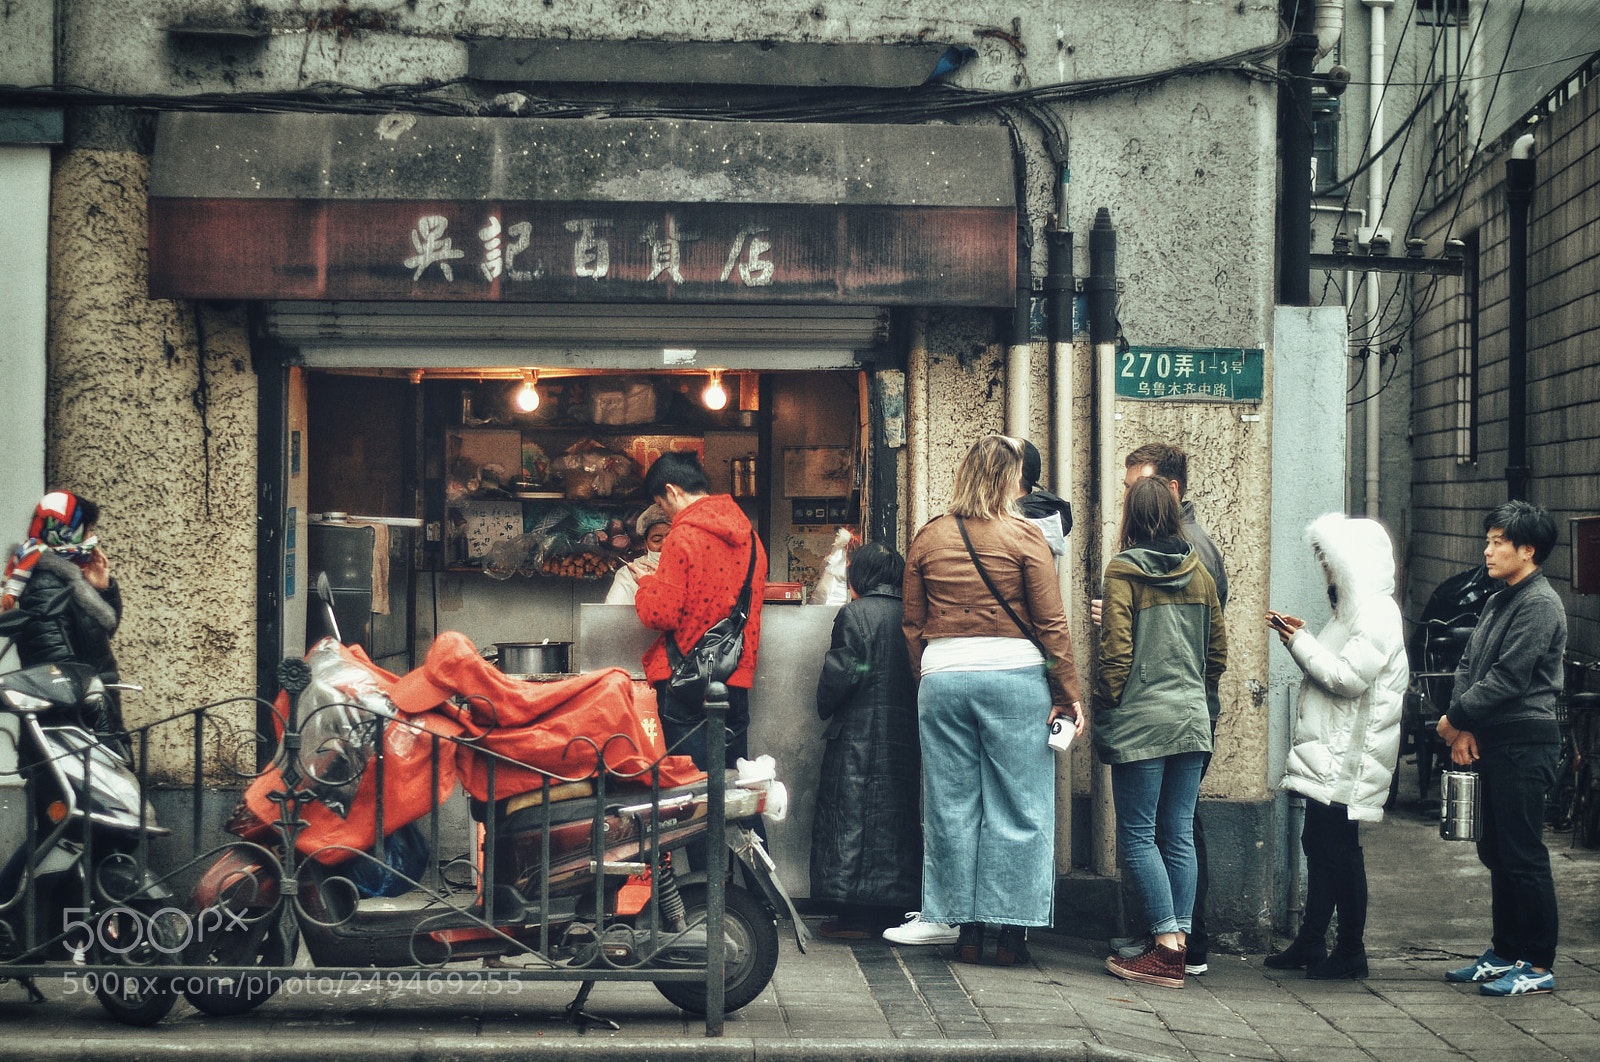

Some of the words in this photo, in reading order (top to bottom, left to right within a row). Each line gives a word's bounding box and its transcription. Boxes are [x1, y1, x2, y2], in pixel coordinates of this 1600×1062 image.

[1121, 352, 1195, 378] 270弄
[1137, 381, 1228, 397] 乌鲁木齐中路
